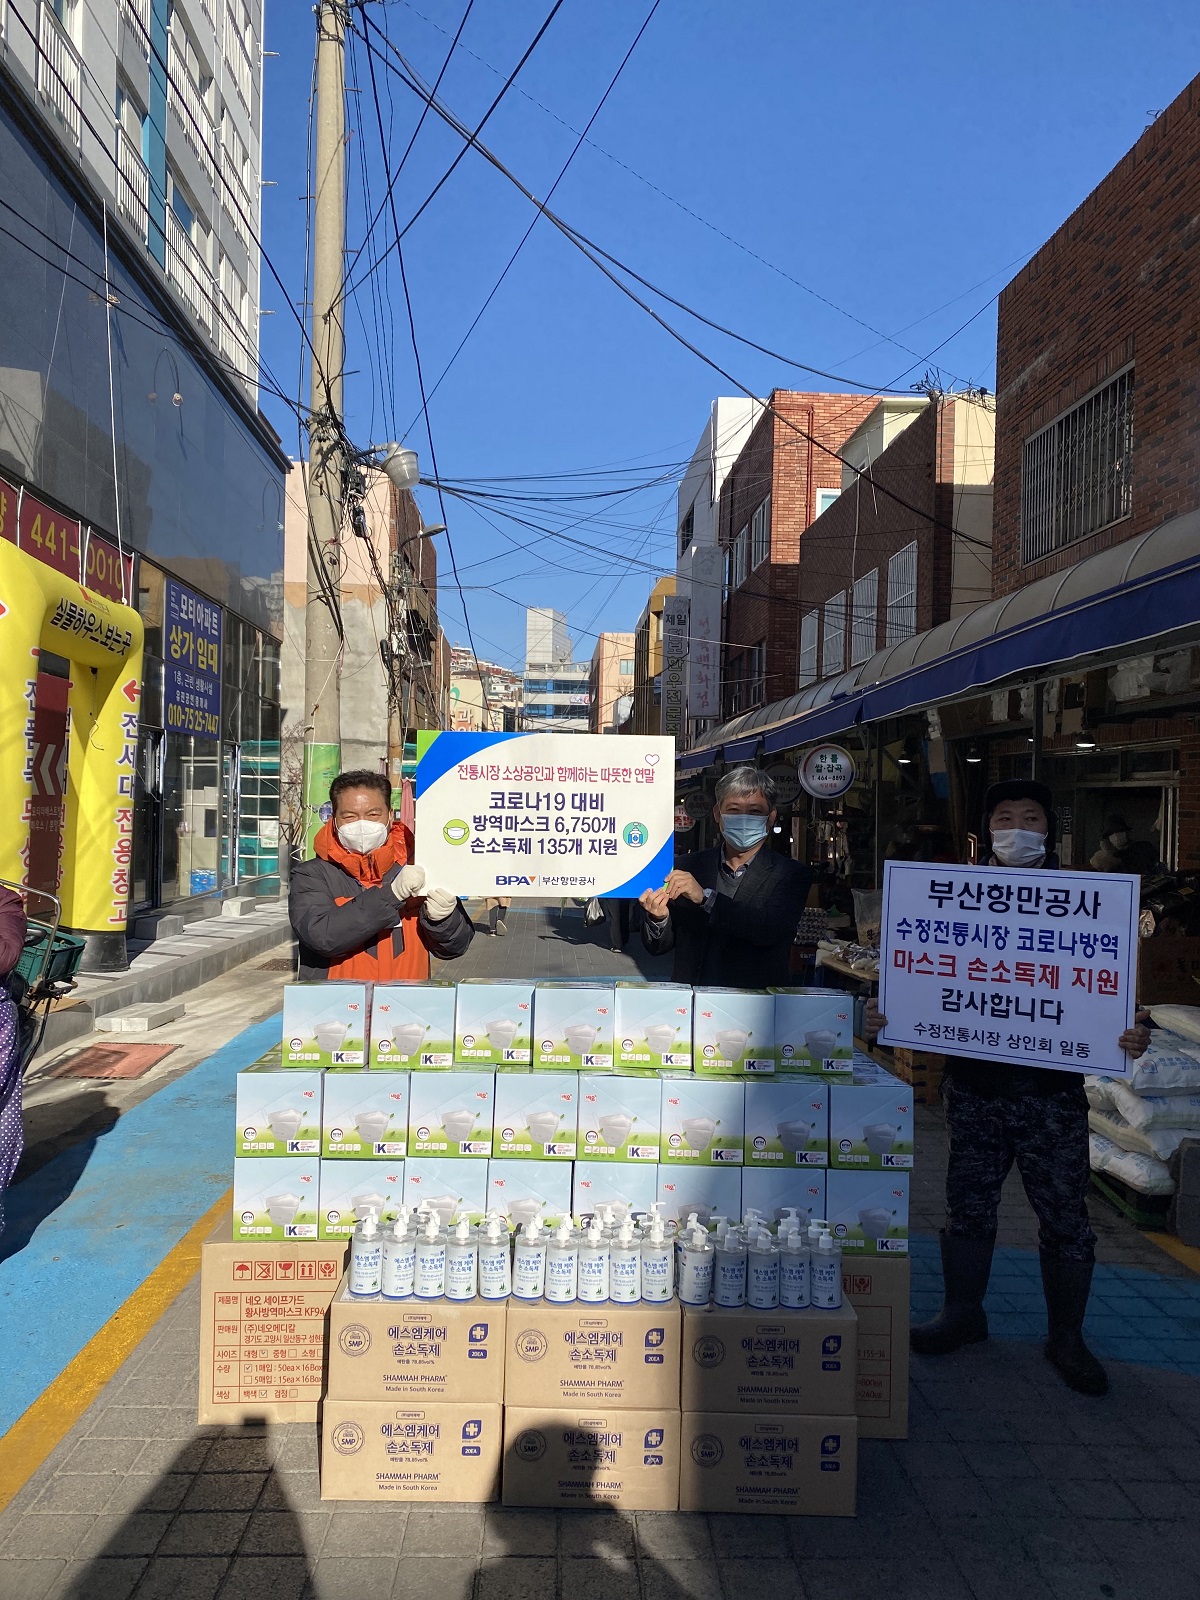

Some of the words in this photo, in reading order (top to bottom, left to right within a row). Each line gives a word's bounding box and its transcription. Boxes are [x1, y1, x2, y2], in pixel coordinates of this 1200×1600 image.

[180, 593, 218, 636] 모티아파트
[666, 614, 686, 626] 제일
[50, 597, 132, 656] 실물하우스보는곳
[169, 625, 194, 664] 상가
[197, 639, 217, 674] 임대
[457, 765, 500, 781] 전통시장
[502, 766, 554, 782] 소상공인과
[557, 767, 598, 783] 함께하는
[600, 768, 631, 783] 따뜻한
[634, 768, 655, 783] 연말
[489, 792, 565, 811] 코로나19
[571, 793, 605, 812] 대비
[472, 815, 550, 833] 방역마스크
[555, 817, 616, 835] 6,750개
[471, 838, 531, 855] 손소독제
[538, 839, 582, 855] 135개
[589, 839, 617, 856] 지원
[496, 876, 531, 885] BPA
[543, 876, 595, 886] 부산항만공사
[928, 880, 1101, 919] 부산항만공사
[896, 917, 1010, 950] 수정전통시장
[1017, 928, 1118, 959] 코로나방역
[894, 950, 957, 977] 마스크
[968, 957, 1059, 989] 손소독제
[1072, 967, 1119, 995] 지원
[942, 988, 1064, 1025] 감사합니다
[914, 1022, 1001, 1046] 수정전통시장
[1007, 1034, 1052, 1053] 상인회
[1060, 1040, 1090, 1058] 일동
[218, 1296, 238, 1304] 제품명
[246, 1296, 261, 1305] 네오
[264, 1296, 304, 1305] 세이프가드
[245, 1308, 302, 1317] 황사방역마스크
[305, 1308, 325, 1316] KF94
[218, 1325, 238, 1334] 판매원
[244, 1324, 295, 1334] (주)네오메디칼
[388, 1326, 447, 1341] 에스엠케어
[244, 1335, 262, 1344] 경기도
[264, 1335, 282, 1344] 고양시
[283, 1335, 307, 1343] 일산동구
[564, 1331, 623, 1346] 에스엠케어
[741, 1338, 800, 1352] 에스엠케어
[217, 1350, 237, 1358] 사이즈
[244, 1350, 258, 1358] 대형
[273, 1350, 286, 1358] 중형
[302, 1349, 315, 1357] 소형
[393, 1342, 441, 1357] 손소독제
[569, 1348, 617, 1362] 손소독제
[217, 1365, 230, 1373] 수량
[746, 1354, 794, 1369] 손소독제
[216, 1390, 230, 1399] 색상
[244, 1390, 257, 1398] 백색
[274, 1390, 288, 1398] 검정
[381, 1423, 439, 1438] 에스엠케어
[386, 1439, 434, 1455] 손소독제
[563, 1432, 622, 1447] 에스엠케어
[740, 1437, 799, 1452] 에스엠케어
[569, 1448, 616, 1463] 손소독제
[745, 1454, 793, 1469] 손소독제
[736, 1486, 771, 1494] SHAMMAH
